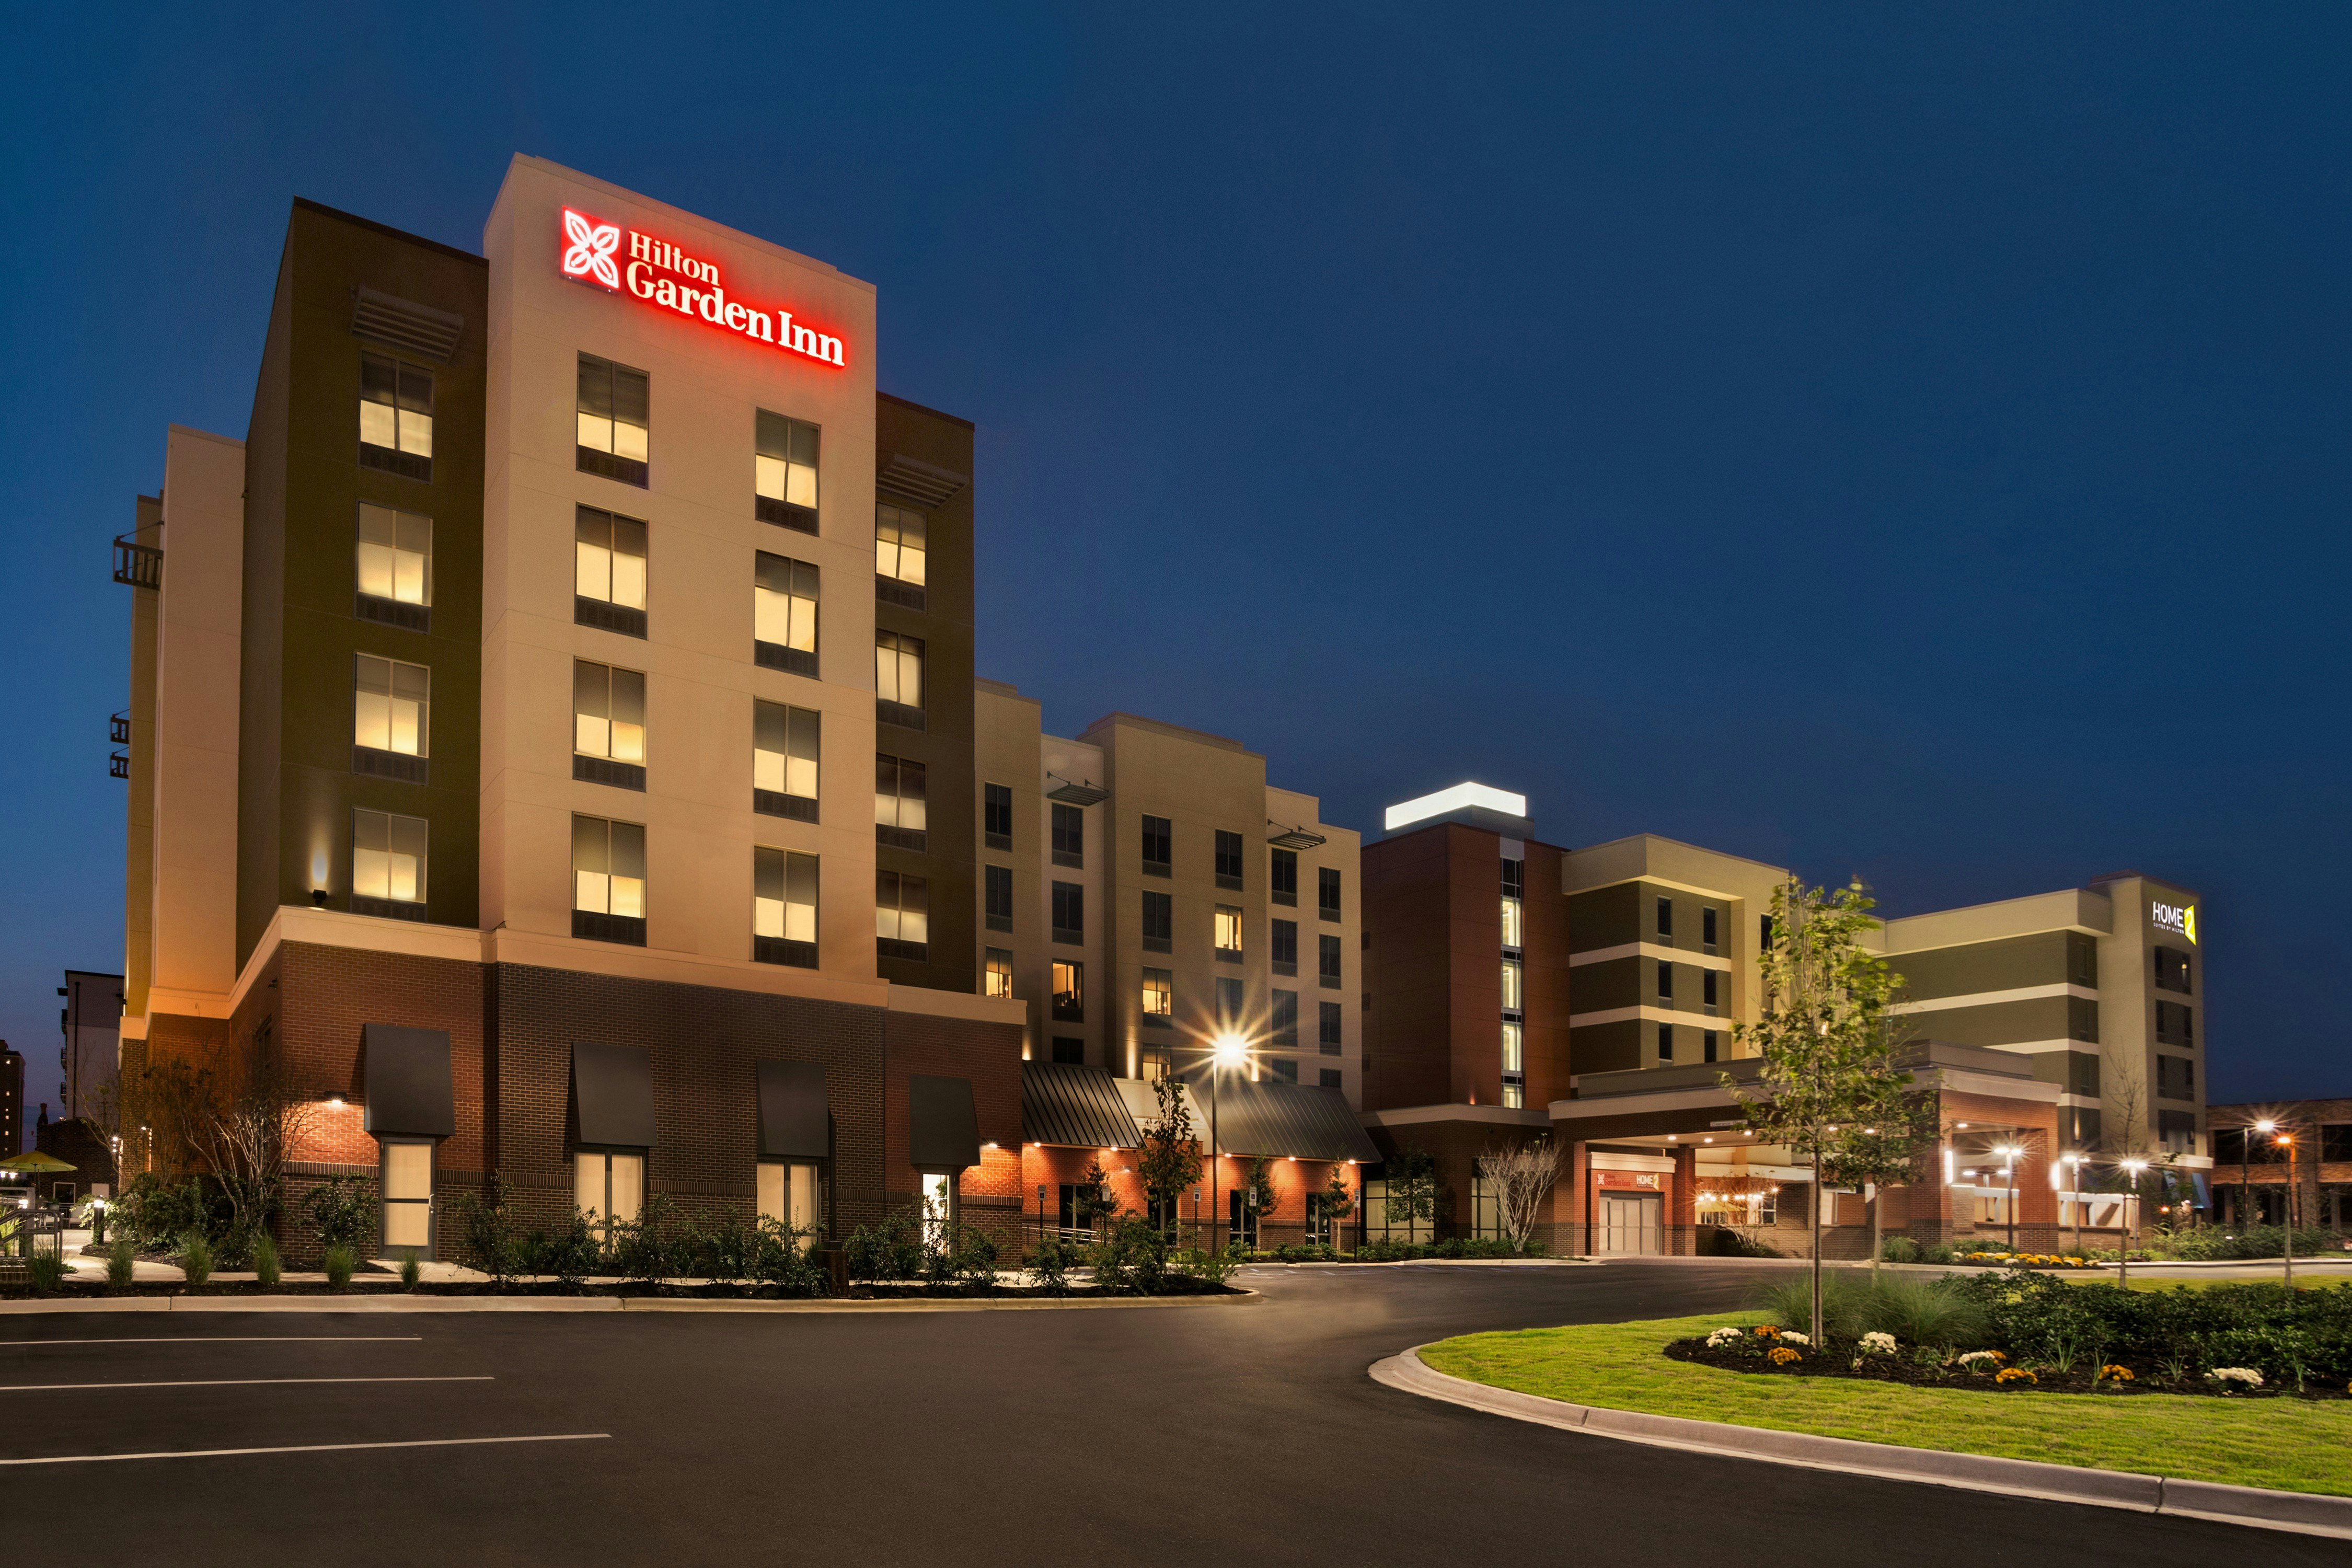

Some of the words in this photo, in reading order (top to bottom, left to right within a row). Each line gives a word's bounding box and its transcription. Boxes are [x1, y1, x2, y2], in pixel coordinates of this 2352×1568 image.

[629, 230, 720, 286] Hilton
[627, 261, 774, 342] Garden
[778, 310, 845, 366] Inn
